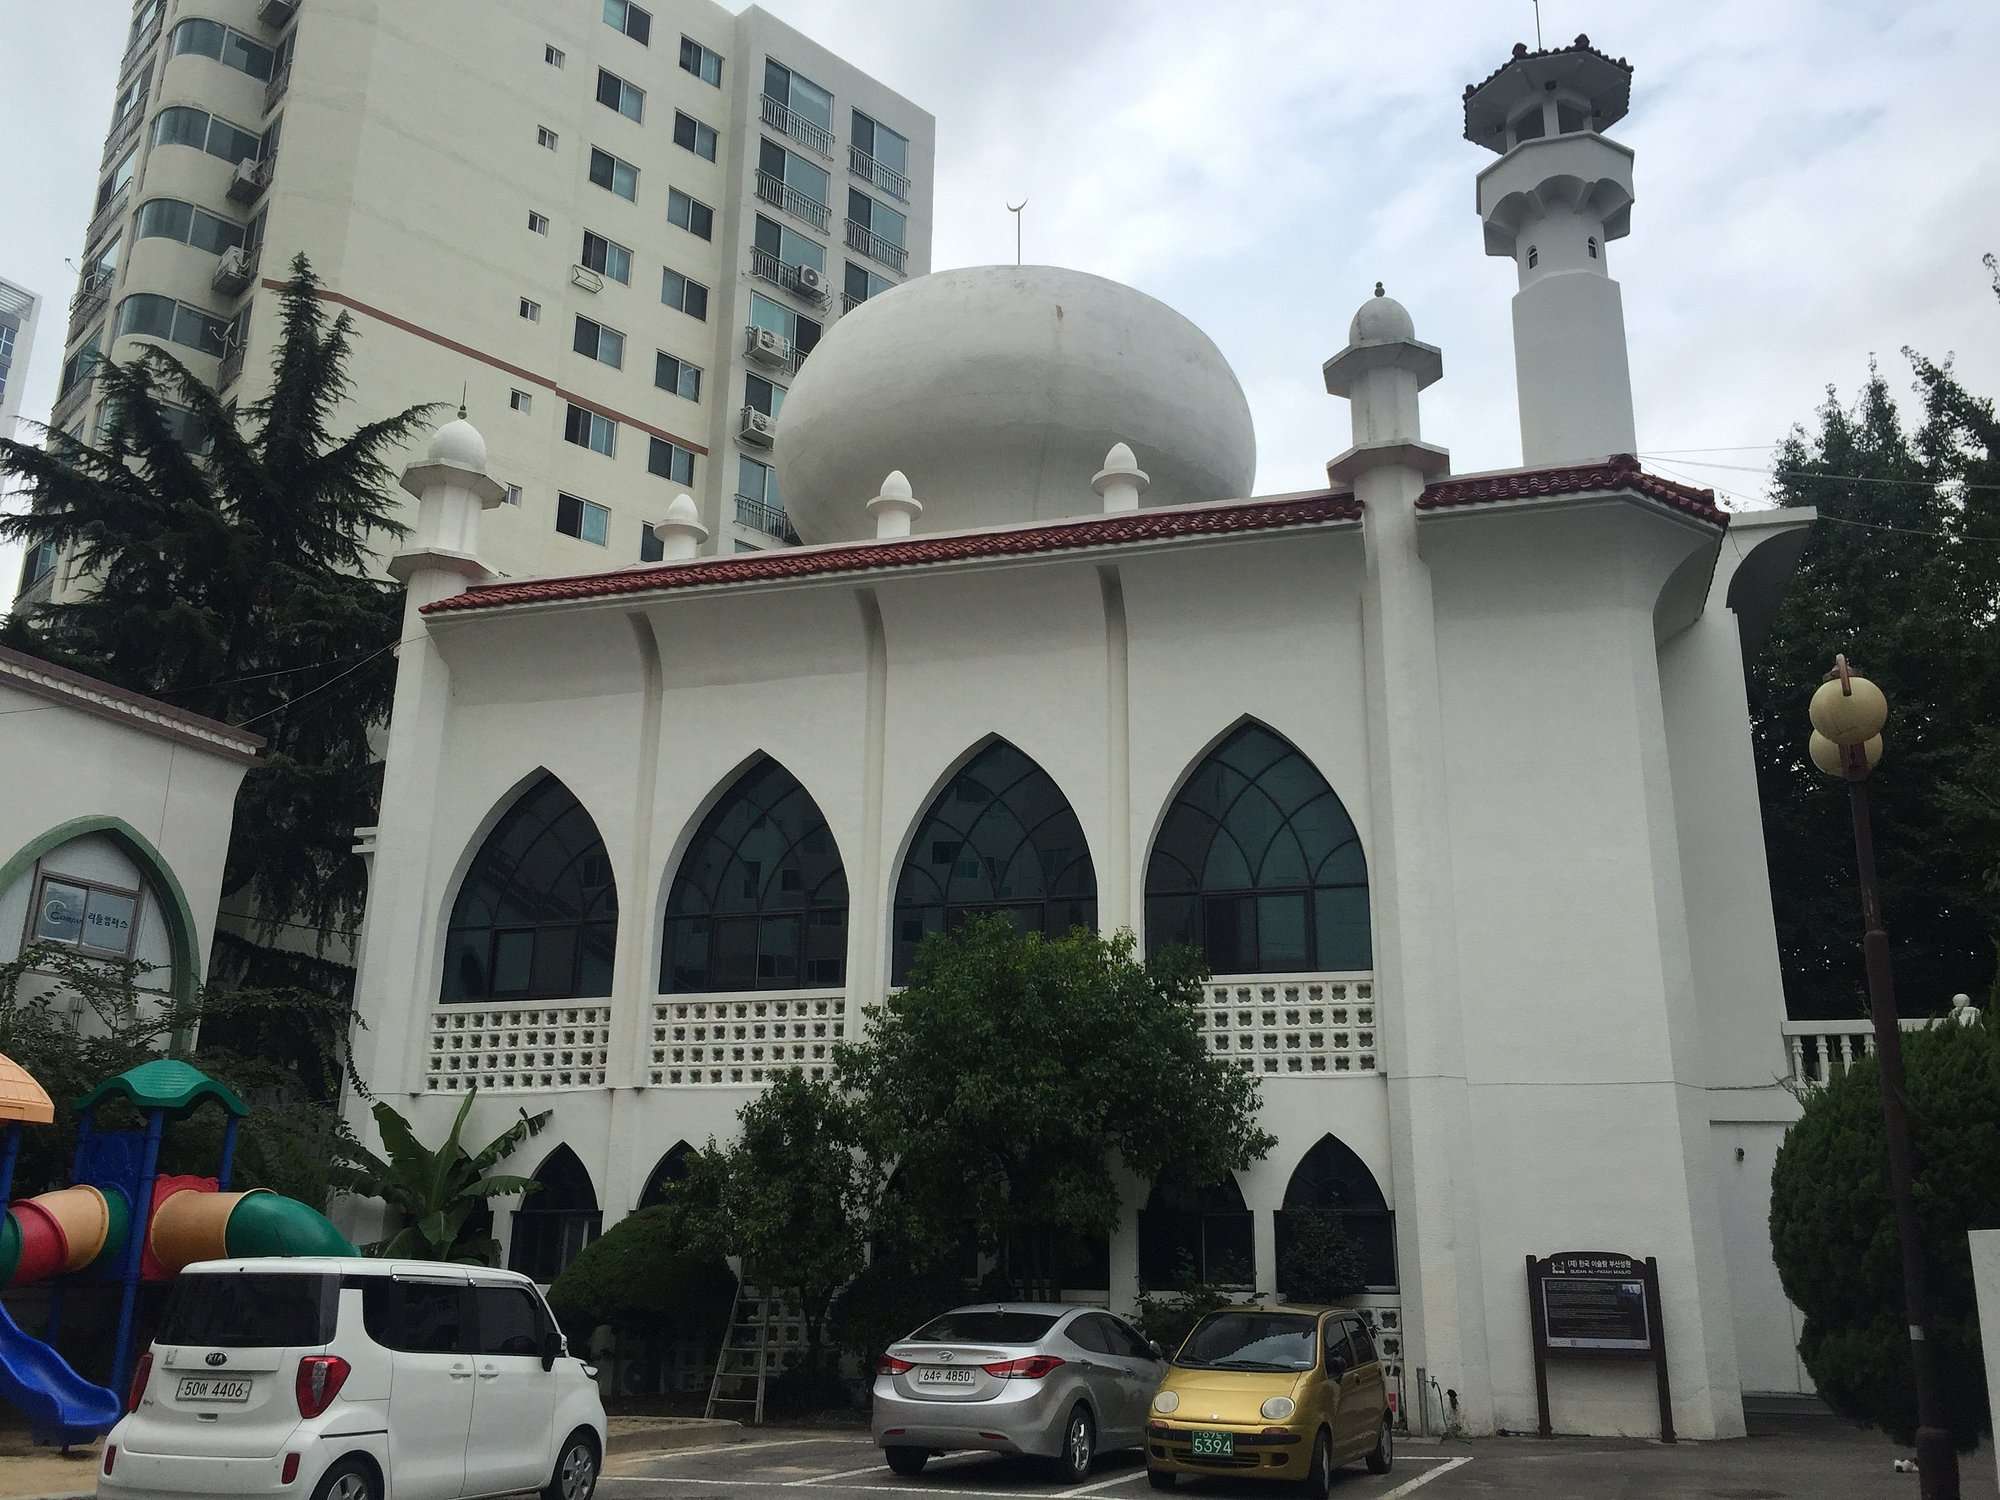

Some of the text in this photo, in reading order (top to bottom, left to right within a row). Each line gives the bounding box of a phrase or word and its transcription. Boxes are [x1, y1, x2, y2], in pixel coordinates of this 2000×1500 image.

[1578, 1259, 1590, 1268] 한국
[1591, 1259, 1608, 1268] 이슬람
[207, 1353, 225, 1364] KIA
[945, 1371, 970, 1382] 4850
[211, 1382, 243, 1398] 4406
[1194, 1438, 1232, 1455] 5394
